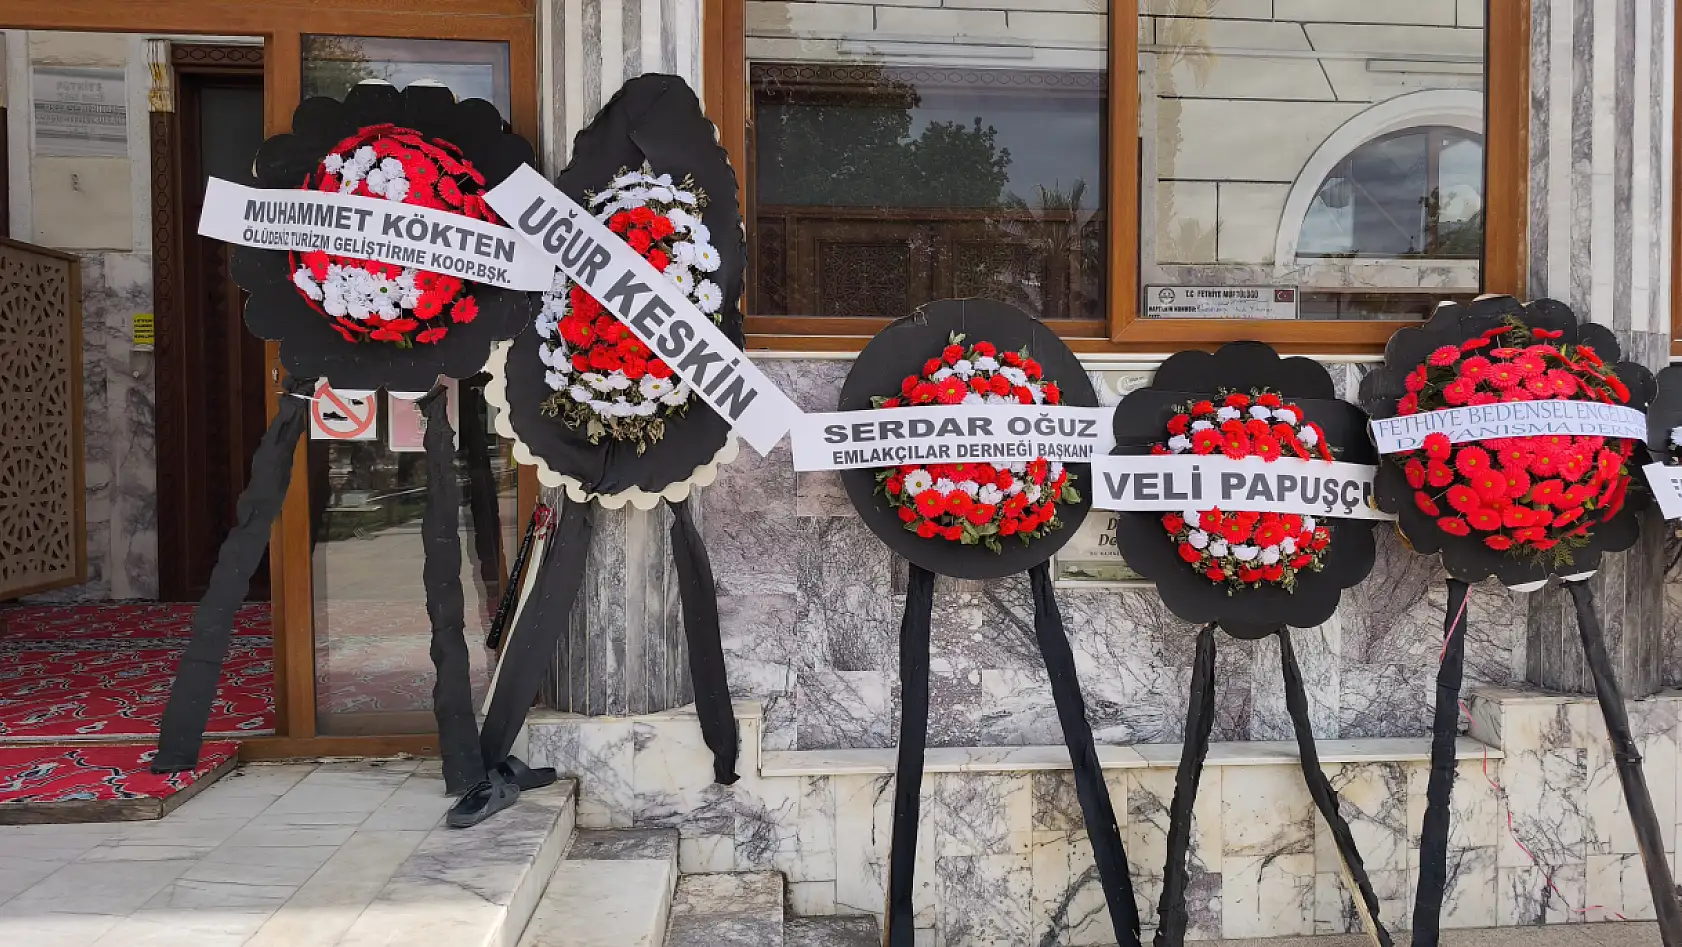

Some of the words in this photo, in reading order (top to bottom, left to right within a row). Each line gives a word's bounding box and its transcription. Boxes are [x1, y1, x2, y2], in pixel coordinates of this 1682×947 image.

[244, 199, 373, 232] MUHAMMET
[382, 213, 516, 263] KÖKTEN
[243, 225, 289, 245] ÖLÜDENİZ
[291, 230, 330, 250] TURİZM
[334, 236, 426, 265] GELİŞTİRME
[430, 252, 511, 283] KOOP.BŞK.
[517, 196, 612, 287] UĞUR
[603, 269, 758, 421] KESKİN
[823, 416, 995, 444] SERDAR
[1007, 412, 1098, 437] OĞUZ
[1467, 401, 1573, 424] BEDENSEL
[832, 444, 950, 465] EMLAKÇILAR
[956, 439, 1033, 458] DERNEĞİ
[1102, 464, 1203, 501] VELİ
